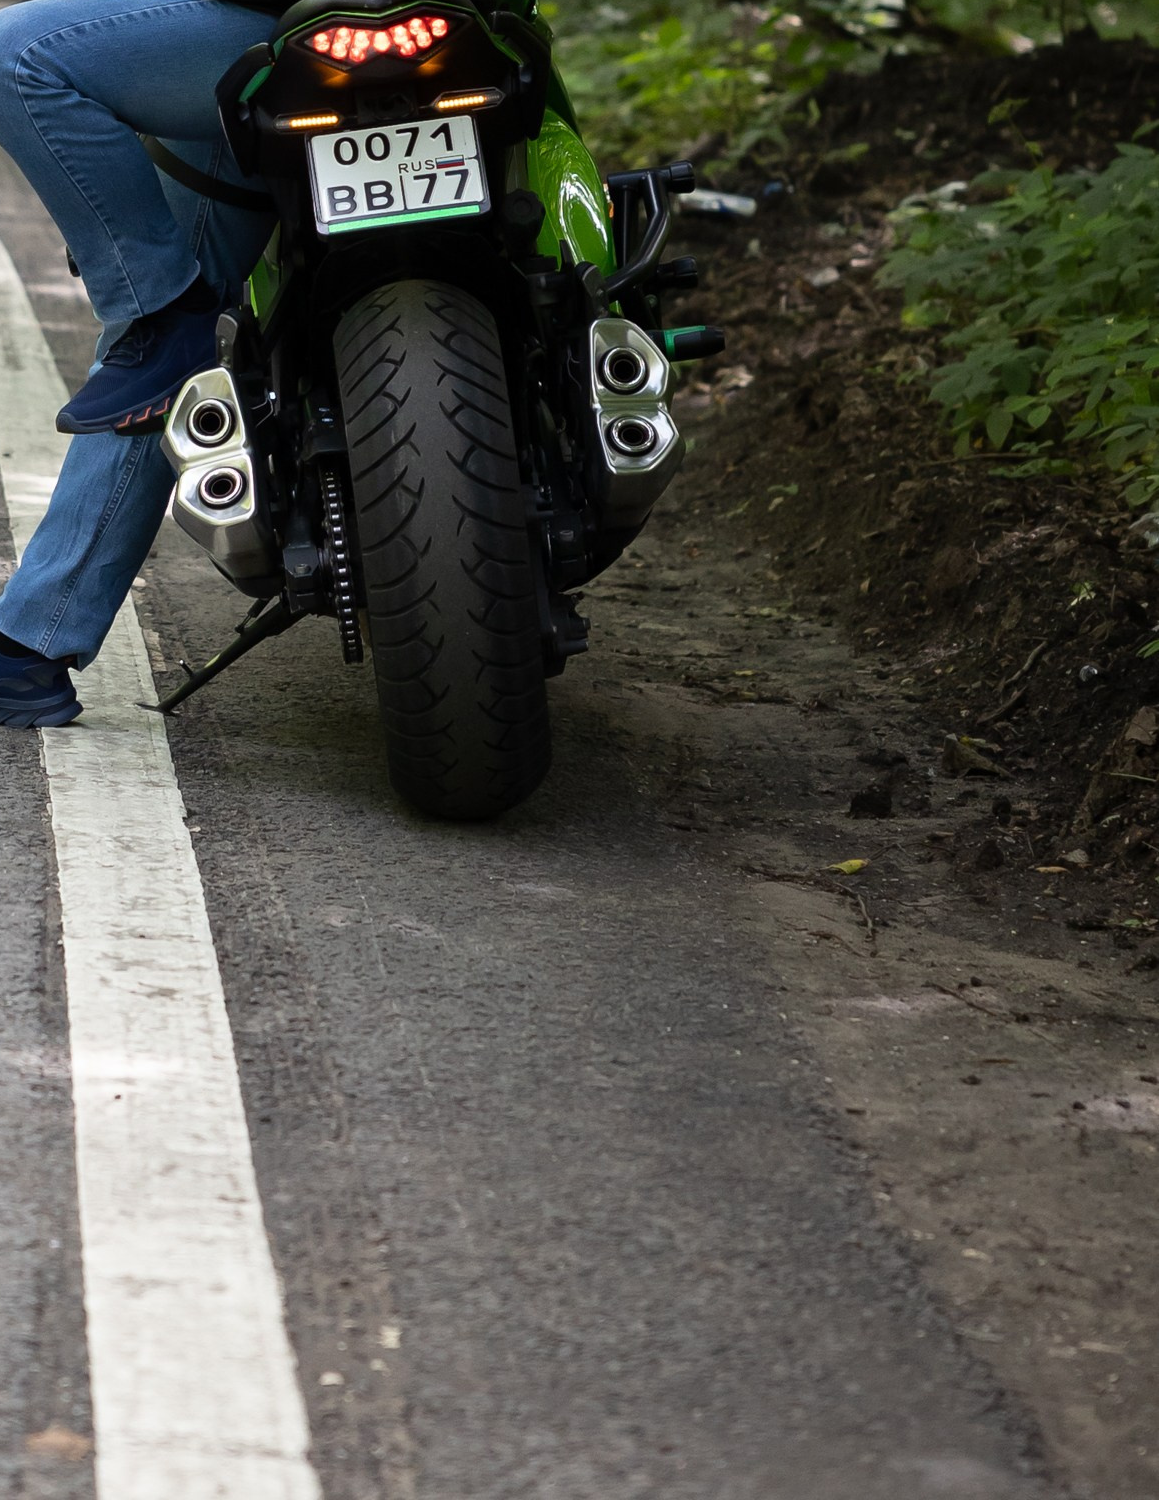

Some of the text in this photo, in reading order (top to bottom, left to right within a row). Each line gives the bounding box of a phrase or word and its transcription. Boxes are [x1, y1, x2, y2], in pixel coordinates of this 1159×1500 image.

[333, 122, 454, 166] 0071
[398, 159, 435, 174] RUS
[413, 168, 469, 205] 77
